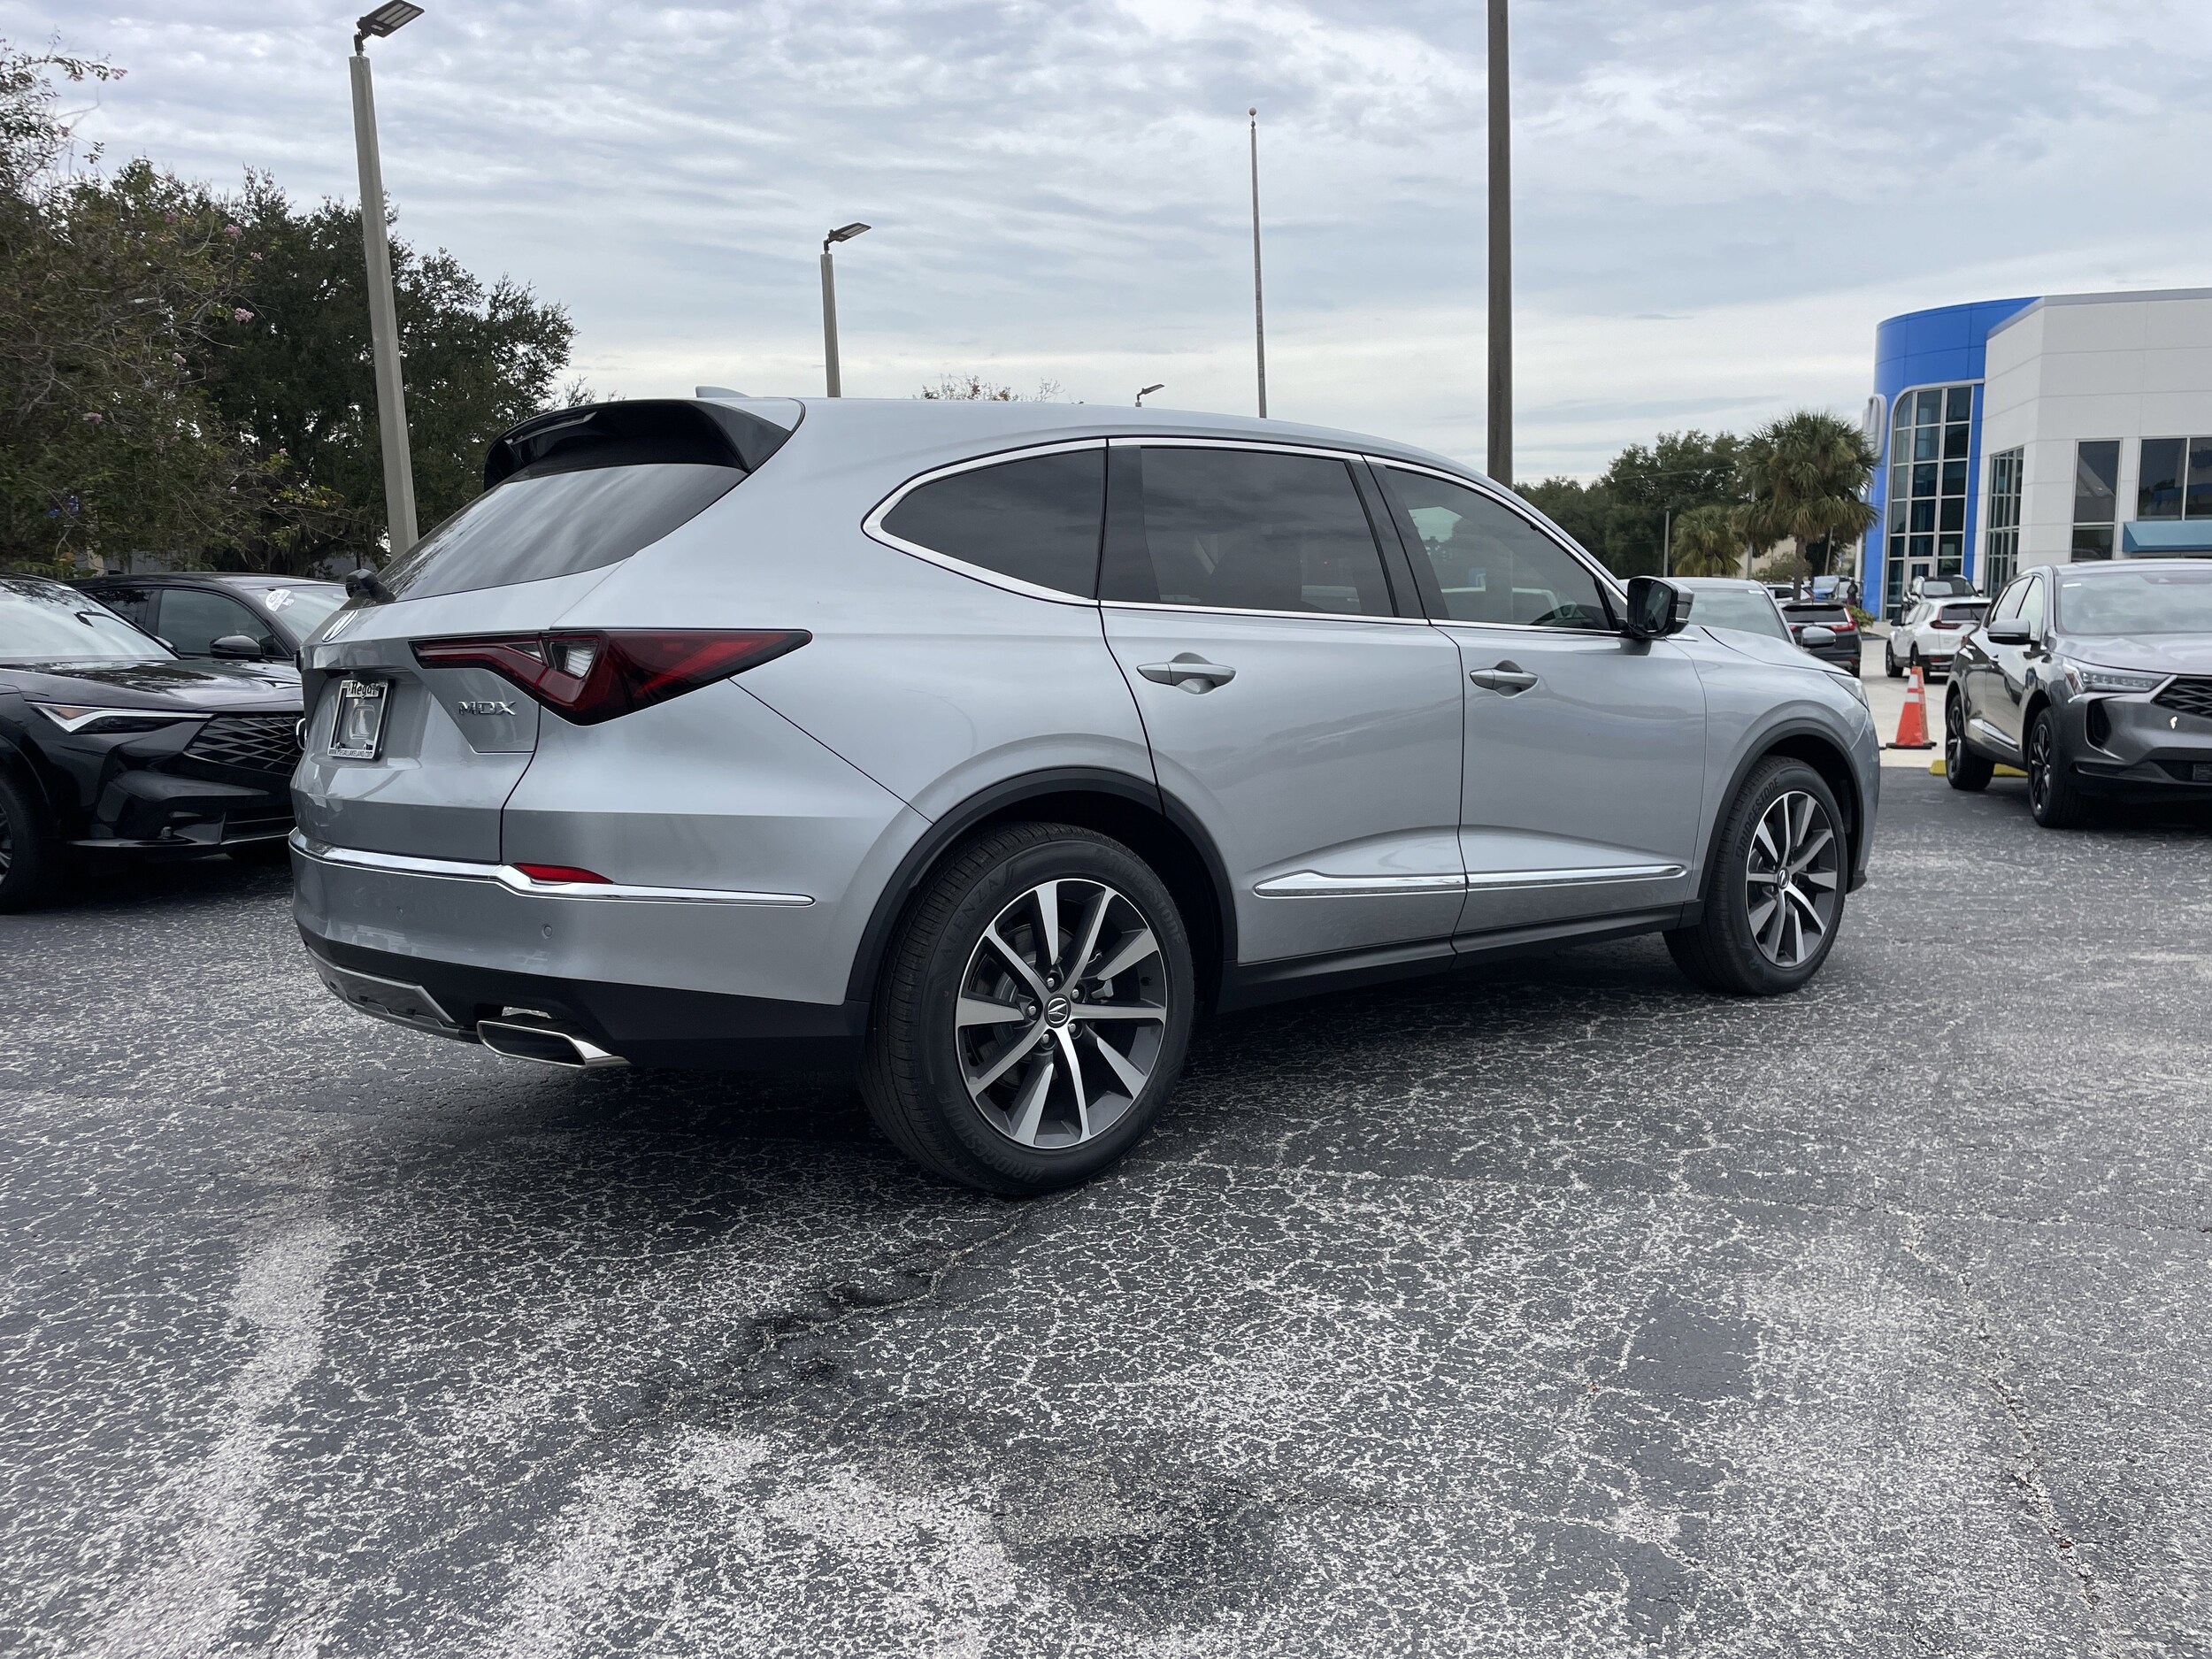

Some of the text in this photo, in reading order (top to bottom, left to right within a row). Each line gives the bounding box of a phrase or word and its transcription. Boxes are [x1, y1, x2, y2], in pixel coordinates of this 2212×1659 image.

[457, 701, 517, 716] MDX
[1736, 777, 1779, 861] BRIDGESTONE
[941, 878, 1000, 958] ALENZA
